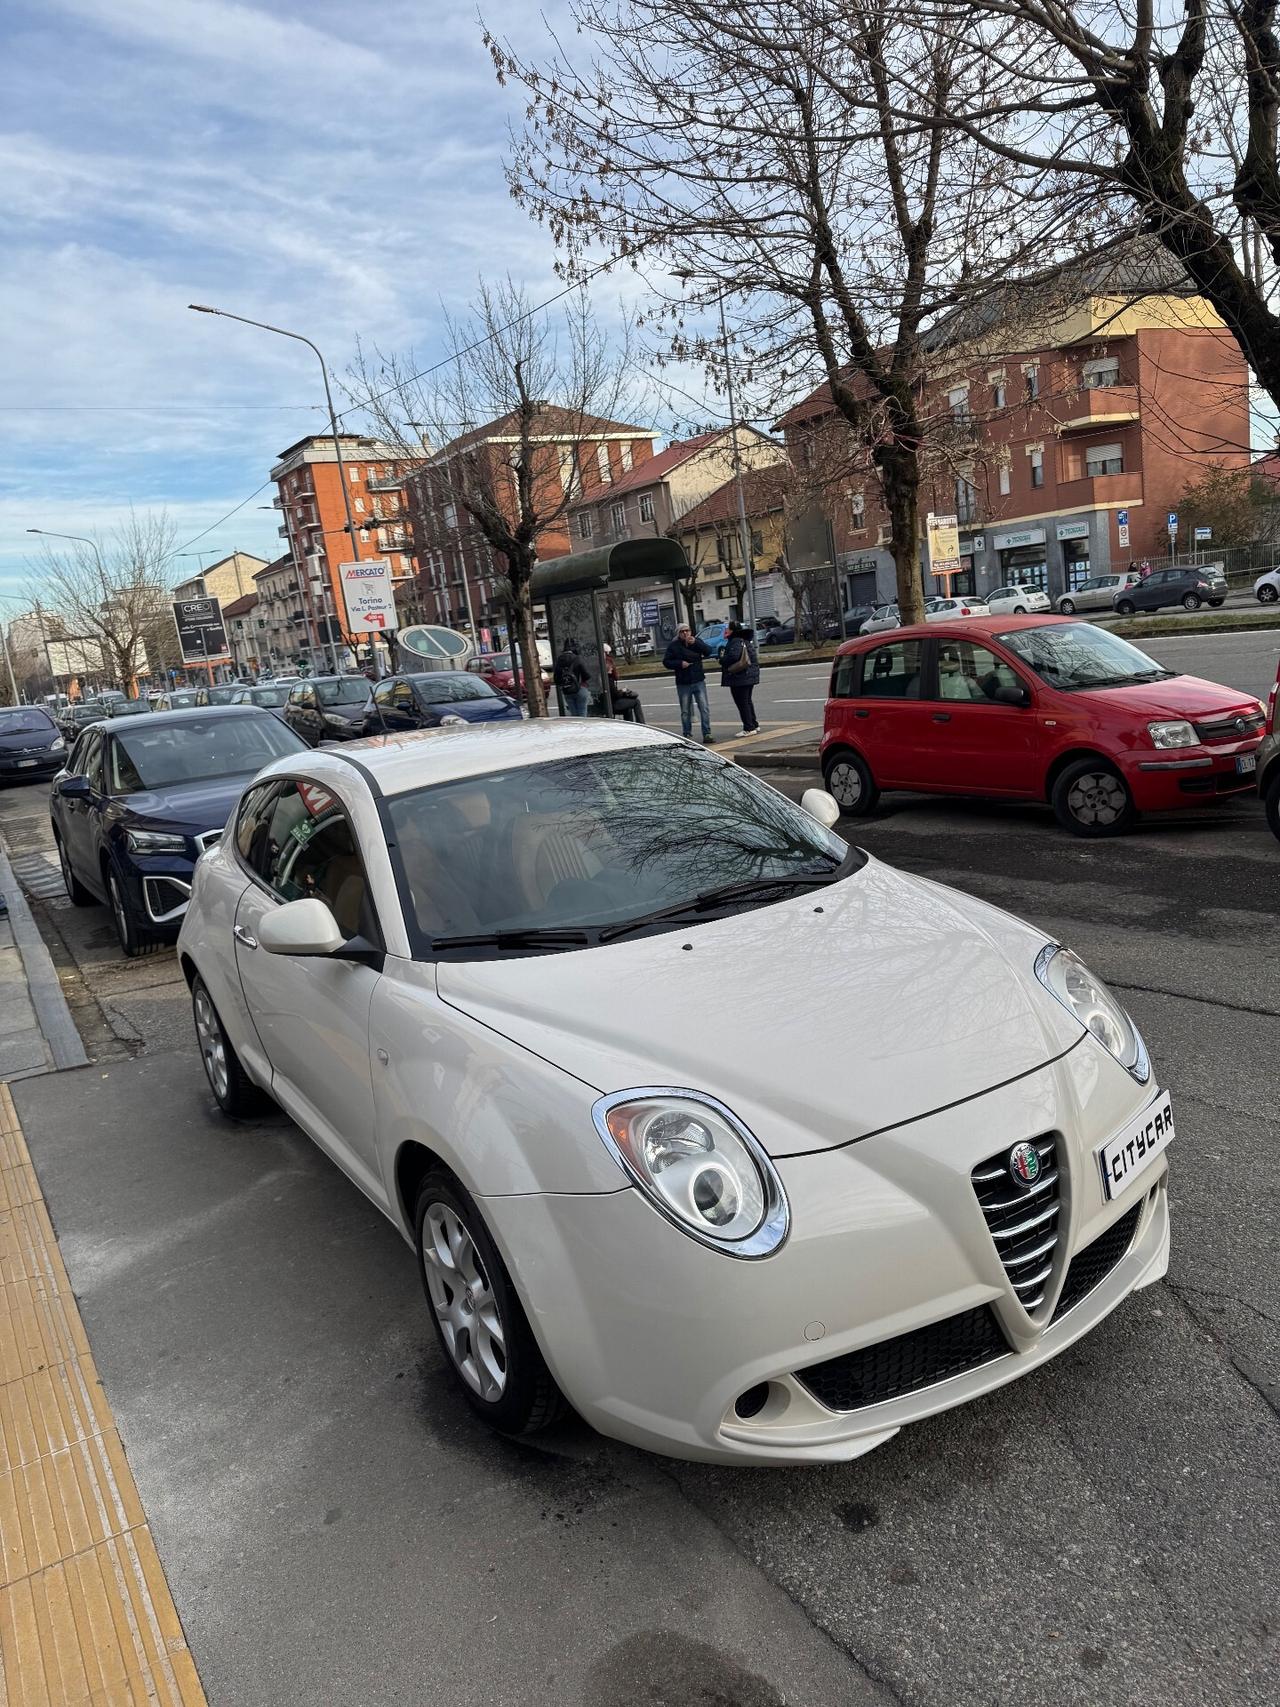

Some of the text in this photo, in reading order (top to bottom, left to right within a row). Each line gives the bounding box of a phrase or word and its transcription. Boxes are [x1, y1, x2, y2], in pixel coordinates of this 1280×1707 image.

[1169, 514, 1176, 523] P
[345, 567, 385, 579] MERCATO
[183, 602, 210, 613] CREO
[1112, 1104, 1172, 1182] CITYCAR
